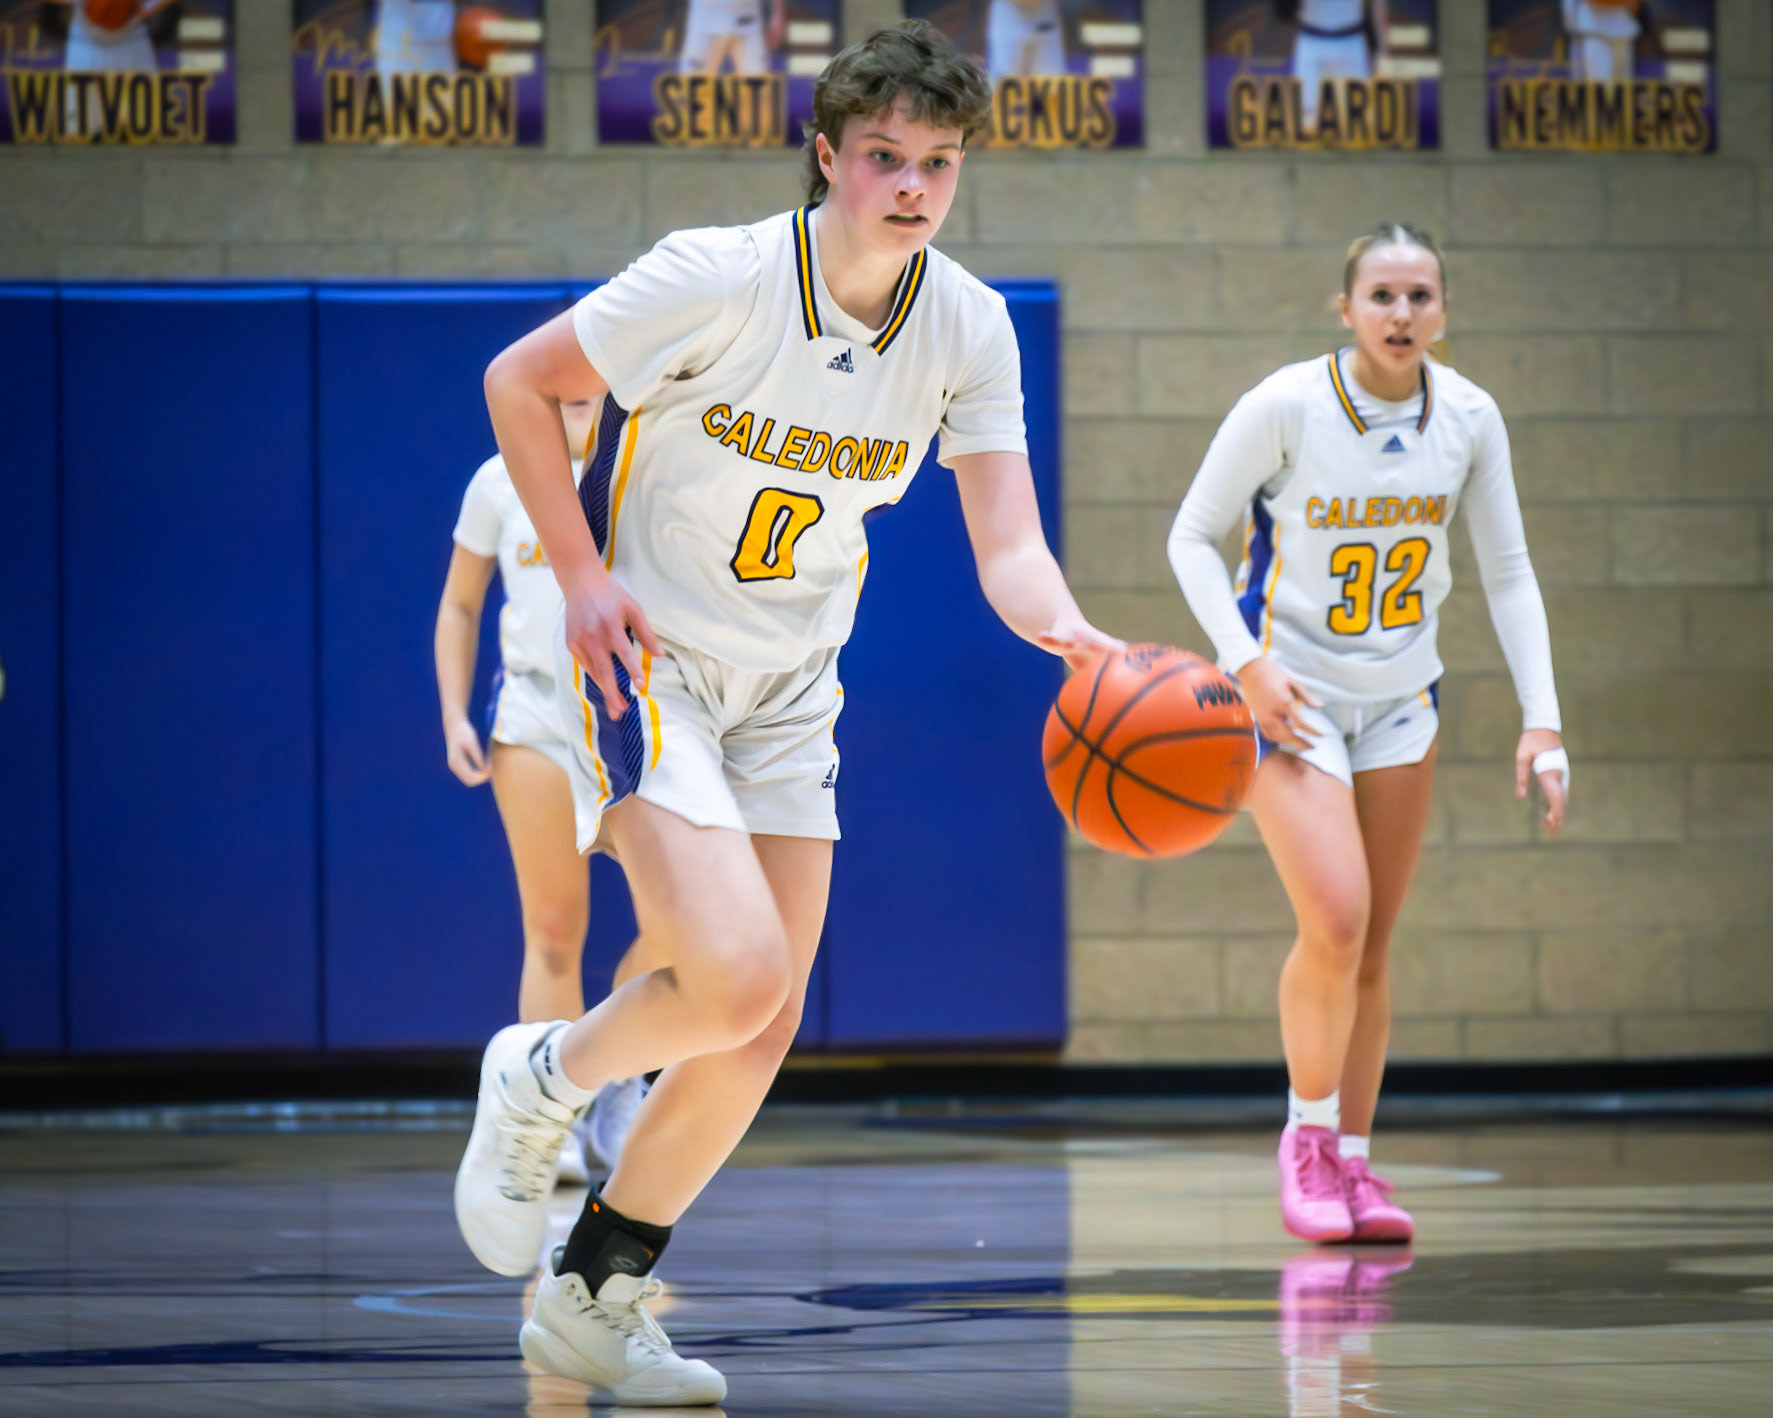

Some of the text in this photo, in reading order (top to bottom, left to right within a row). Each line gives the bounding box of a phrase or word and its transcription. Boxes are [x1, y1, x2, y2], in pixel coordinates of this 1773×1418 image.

[9, 72, 210, 140] WITVOET
[325, 72, 516, 142] HANSON
[655, 73, 787, 145] SENTI
[988, 76, 1115, 144] CKUS
[1230, 76, 1418, 149] GALARDI
[1499, 79, 1709, 151] NEMMERS
[702, 403, 909, 481] CALEDONIA
[729, 487, 825, 583] 0
[1327, 537, 1432, 635] 32
